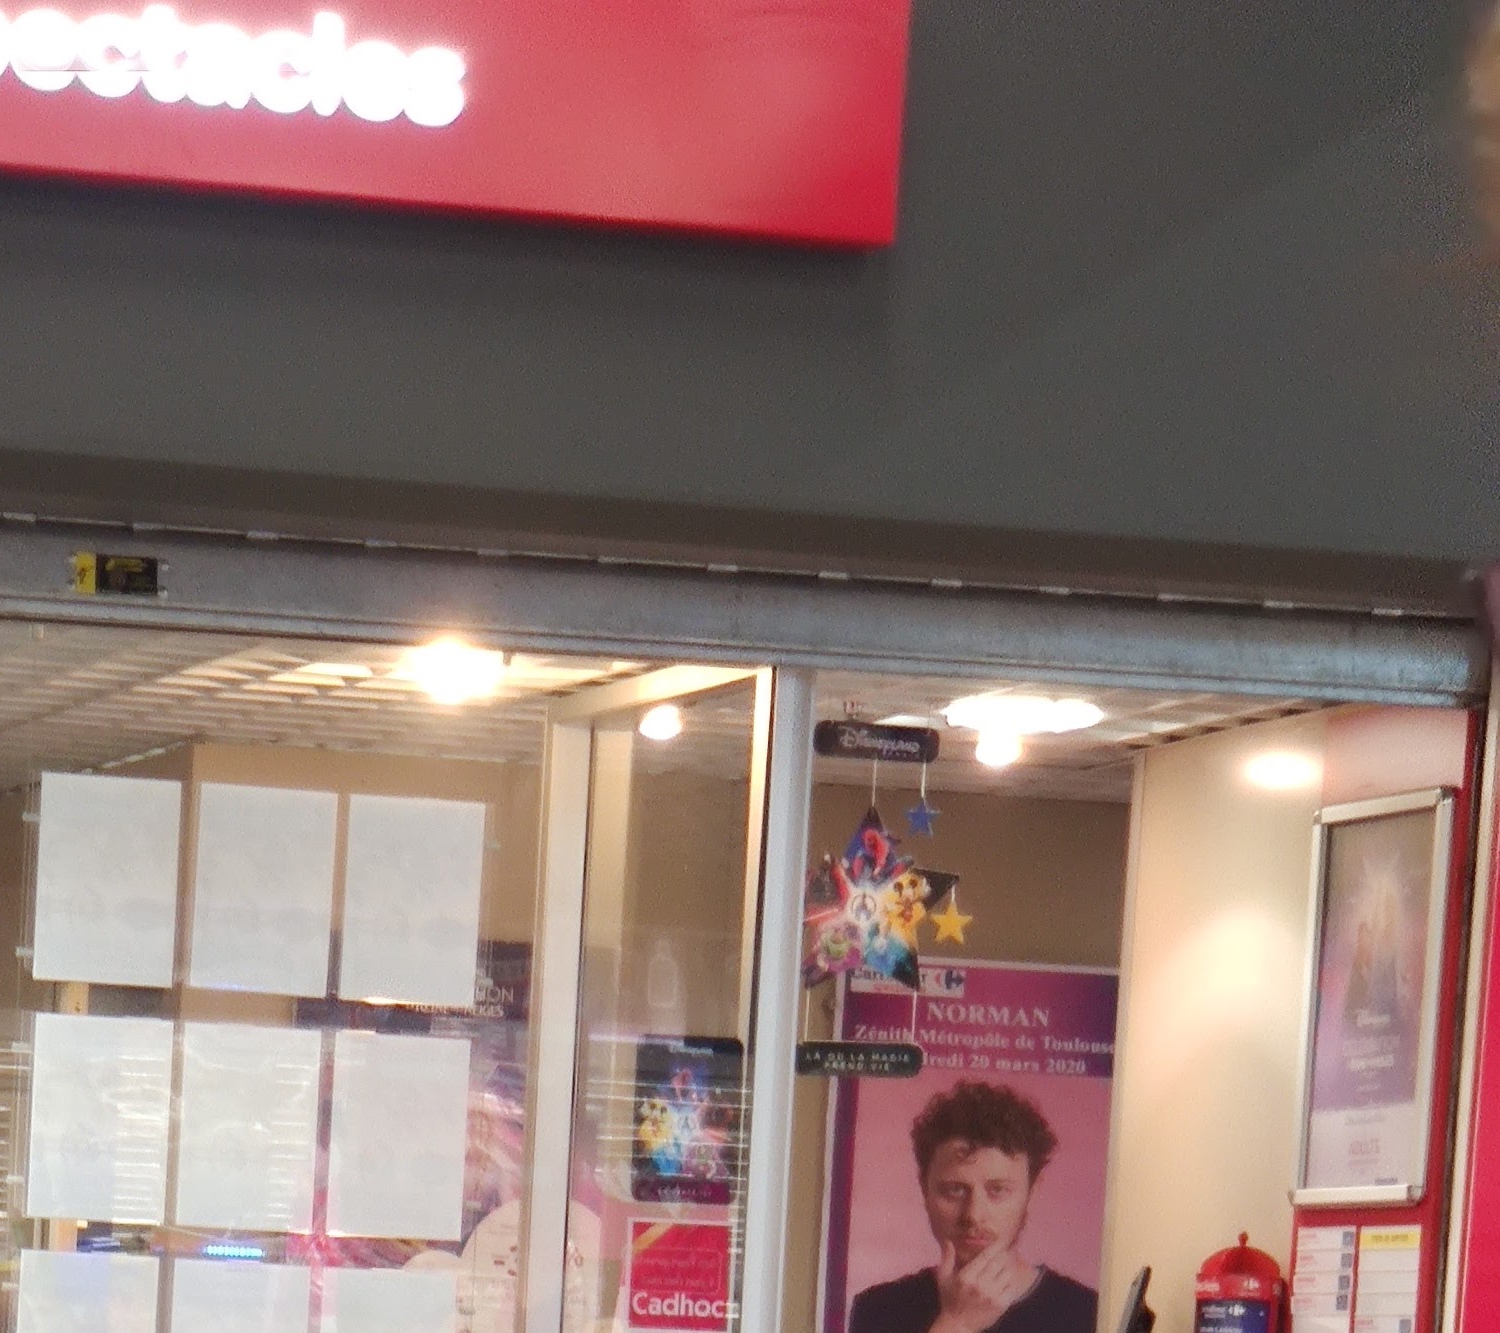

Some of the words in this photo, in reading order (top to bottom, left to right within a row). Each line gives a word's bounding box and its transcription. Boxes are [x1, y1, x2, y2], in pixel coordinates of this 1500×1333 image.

[927, 1001, 1050, 1028] NORMAN
[919, 1028, 1012, 1051] Métropôle
[1015, 1034, 1035, 1051] de
[967, 1051, 990, 1068] 20
[994, 1057, 1040, 1072] mars
[1046, 1055, 1086, 1074] 2020
[632, 1291, 727, 1319] Cadhoc
